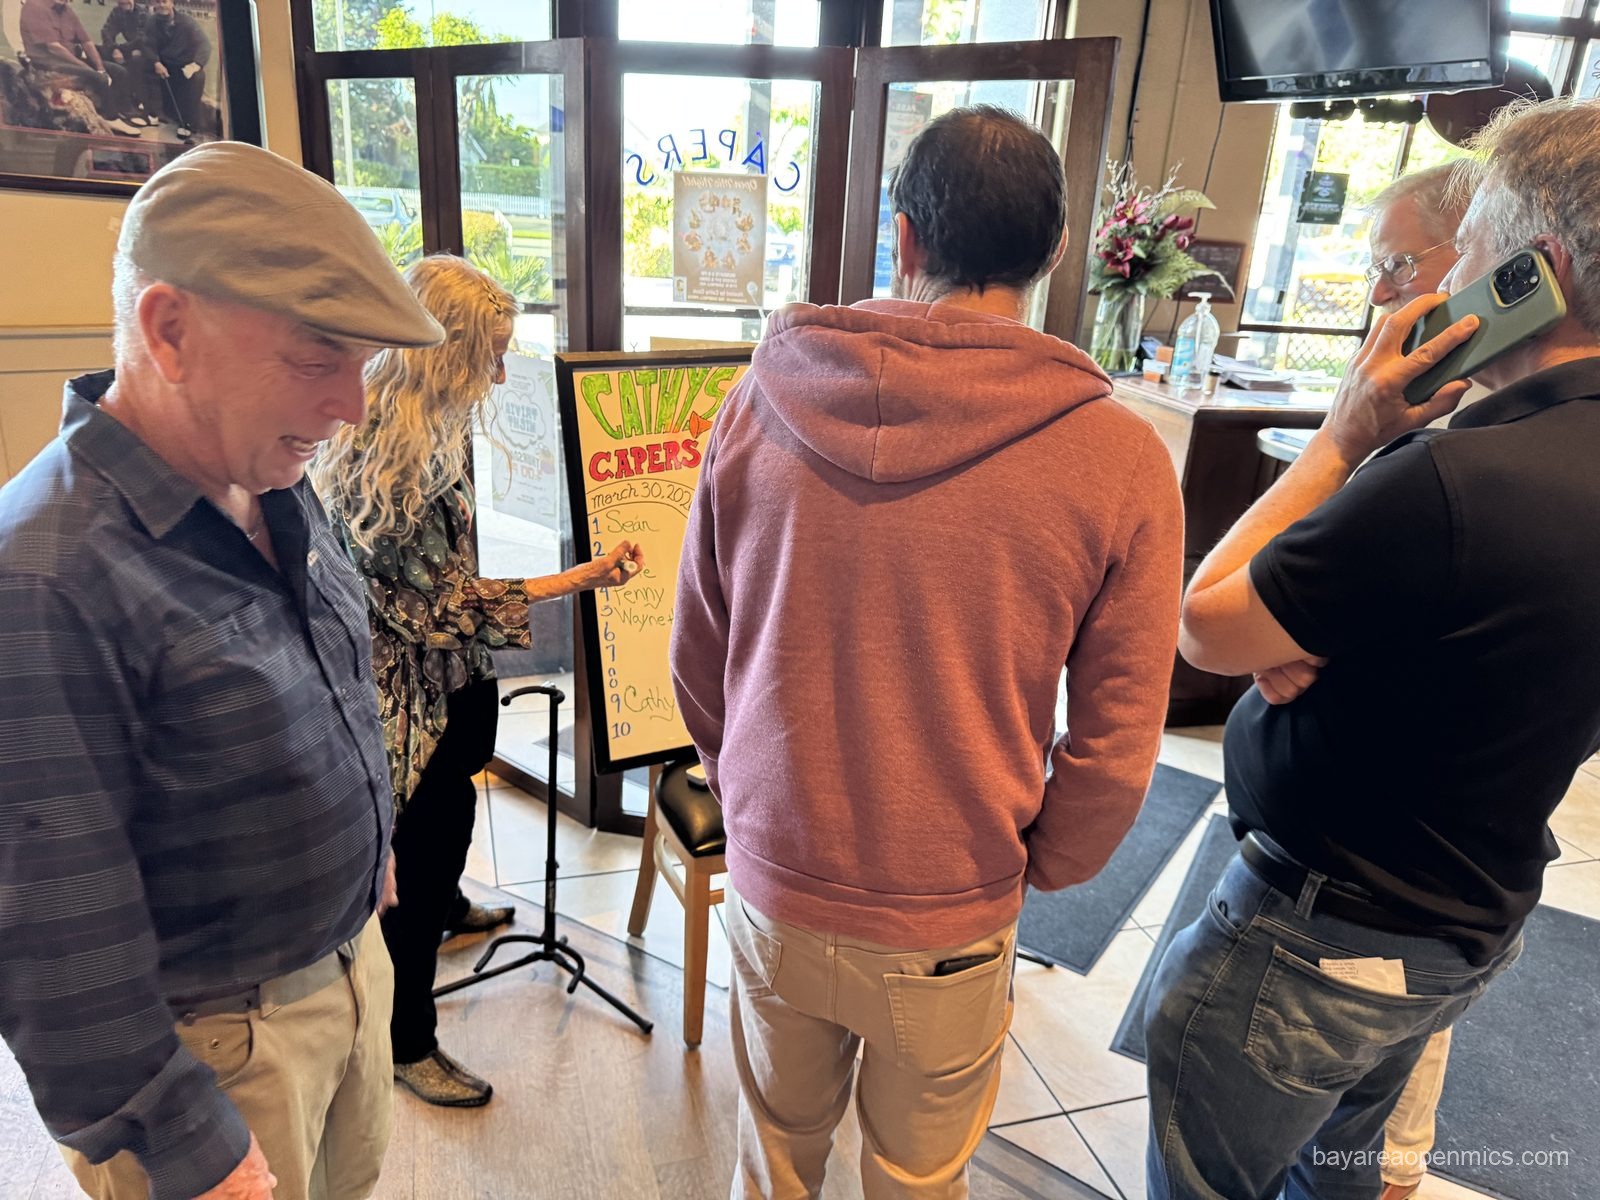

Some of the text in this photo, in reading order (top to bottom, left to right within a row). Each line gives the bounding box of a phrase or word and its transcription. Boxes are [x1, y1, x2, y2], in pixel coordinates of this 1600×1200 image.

[589, 439, 702, 481] CAPERS
[667, 484, 693, 511] 202
[592, 517, 602, 535] 1
[604, 621, 615, 642] 6
[606, 644, 615, 662] 7
[608, 667, 618, 688] 8
[610, 685, 676, 721] 9 Cathy
[611, 721, 631, 740] 10
